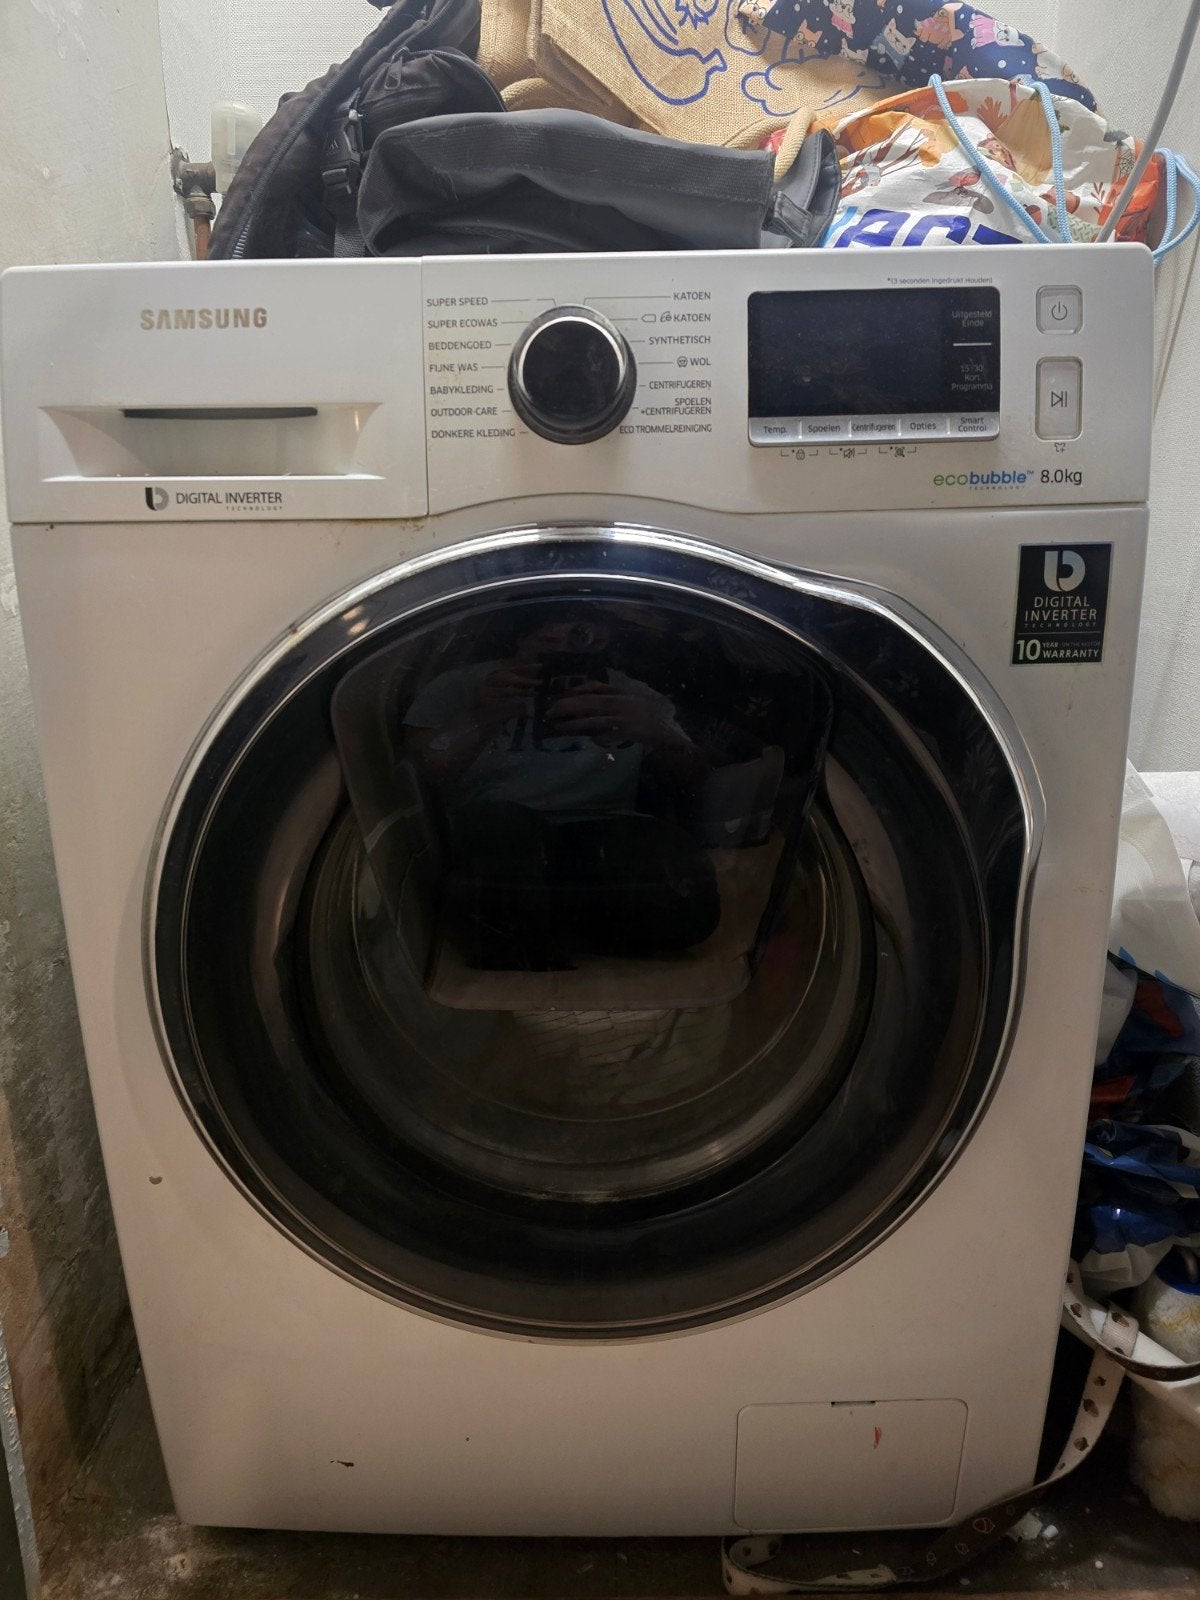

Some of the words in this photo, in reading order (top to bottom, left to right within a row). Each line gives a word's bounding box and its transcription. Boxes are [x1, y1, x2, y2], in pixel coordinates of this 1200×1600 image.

[674, 292, 711, 300] KATOEN
[426, 298, 456, 307] SUPER
[458, 297, 488, 306] SPEED
[140, 308, 268, 330] SAMSUNG
[674, 313, 711, 322] KATOEN
[428, 320, 458, 328] SUPER
[460, 318, 498, 328] ECOWAS
[962, 319, 984, 327] Einde
[649, 336, 711, 345] SYNTHETISCH
[428, 341, 492, 350] BEDDENGOED
[690, 358, 711, 366] WOL
[429, 364, 455, 372] FIJNE
[458, 363, 478, 372] WAS
[649, 380, 712, 389] CENTRIFUGEREN
[430, 385, 494, 395] BABYKLEDING
[674, 398, 712, 406] SPOELEN
[620, 425, 634, 434] ECO
[636, 424, 712, 434] TROMMELREINIGING
[763, 426, 788, 434] Temp.
[808, 424, 841, 434] Spoelen
[852, 423, 896, 432] Centrifugeren
[910, 422, 937, 431] Opties
[431, 429, 474, 438] DONKERE
[476, 428, 516, 437] KLEDING
[1040, 469, 1082, 486] 8.0kg
[176, 492, 222, 504] DIGITAL
[226, 492, 282, 504] INVERTER
[1034, 596, 1090, 608] DIGITAL
[1024, 609, 1097, 621] INVERTER
[1016, 639, 1040, 660] 10
[1042, 649, 1099, 658] WARRANTY
